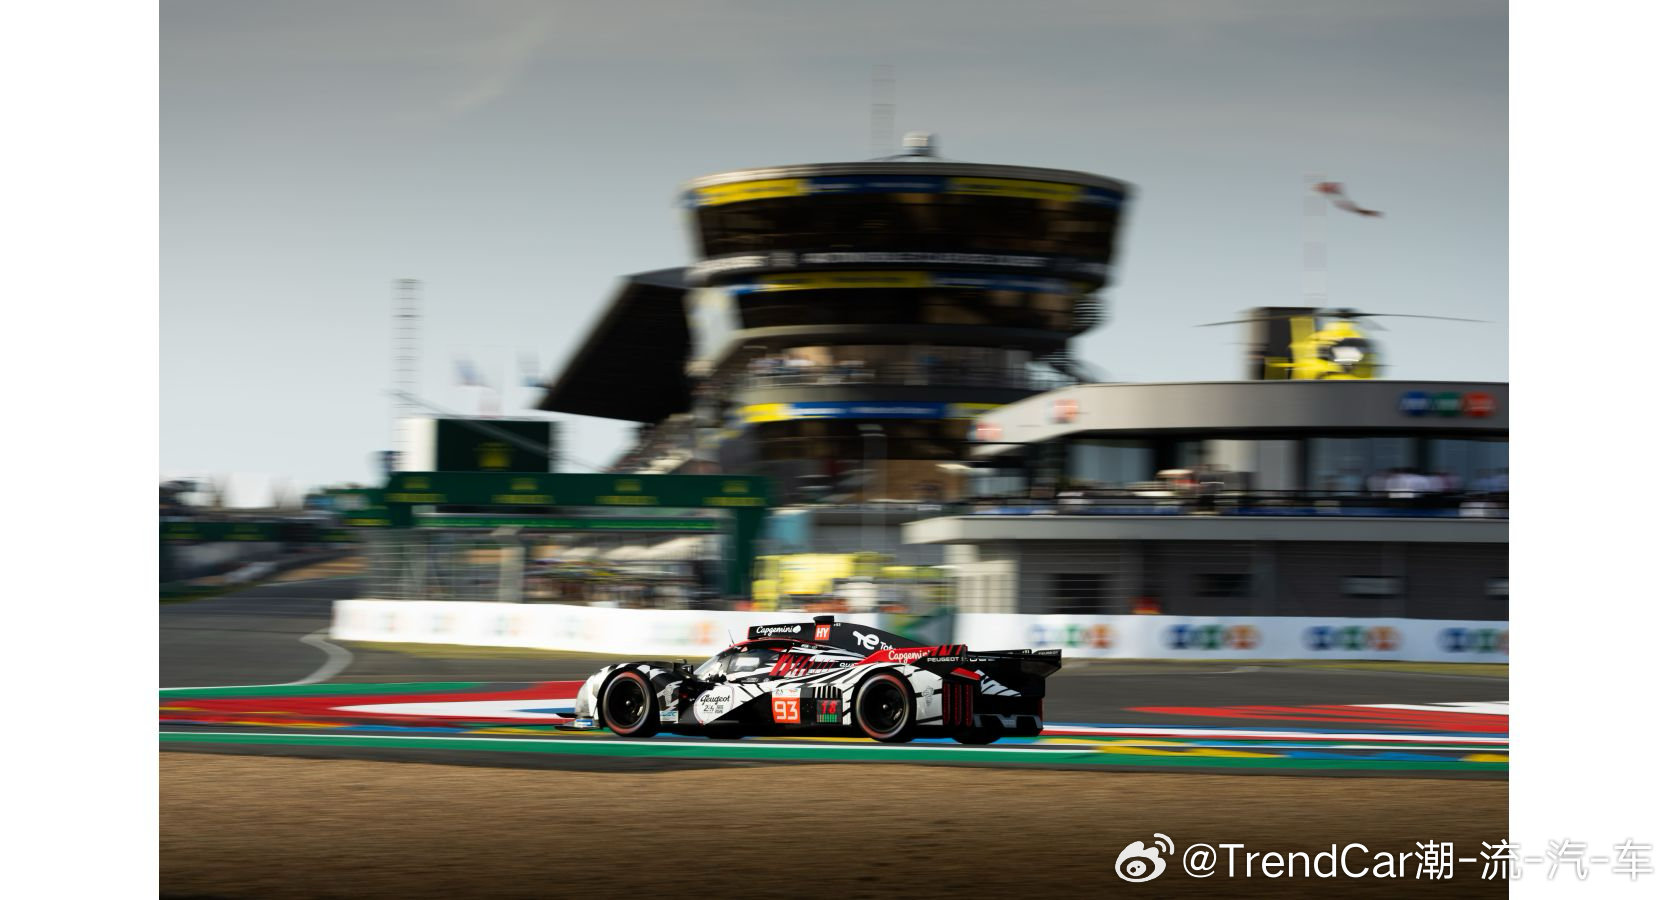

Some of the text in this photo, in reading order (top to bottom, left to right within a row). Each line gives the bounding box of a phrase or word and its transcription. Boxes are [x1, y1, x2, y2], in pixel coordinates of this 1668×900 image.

[756, 625, 793, 637] Capgemini
[816, 627, 829, 638] HY
[700, 694, 730, 705] Peugeot
[774, 700, 798, 720] 93
